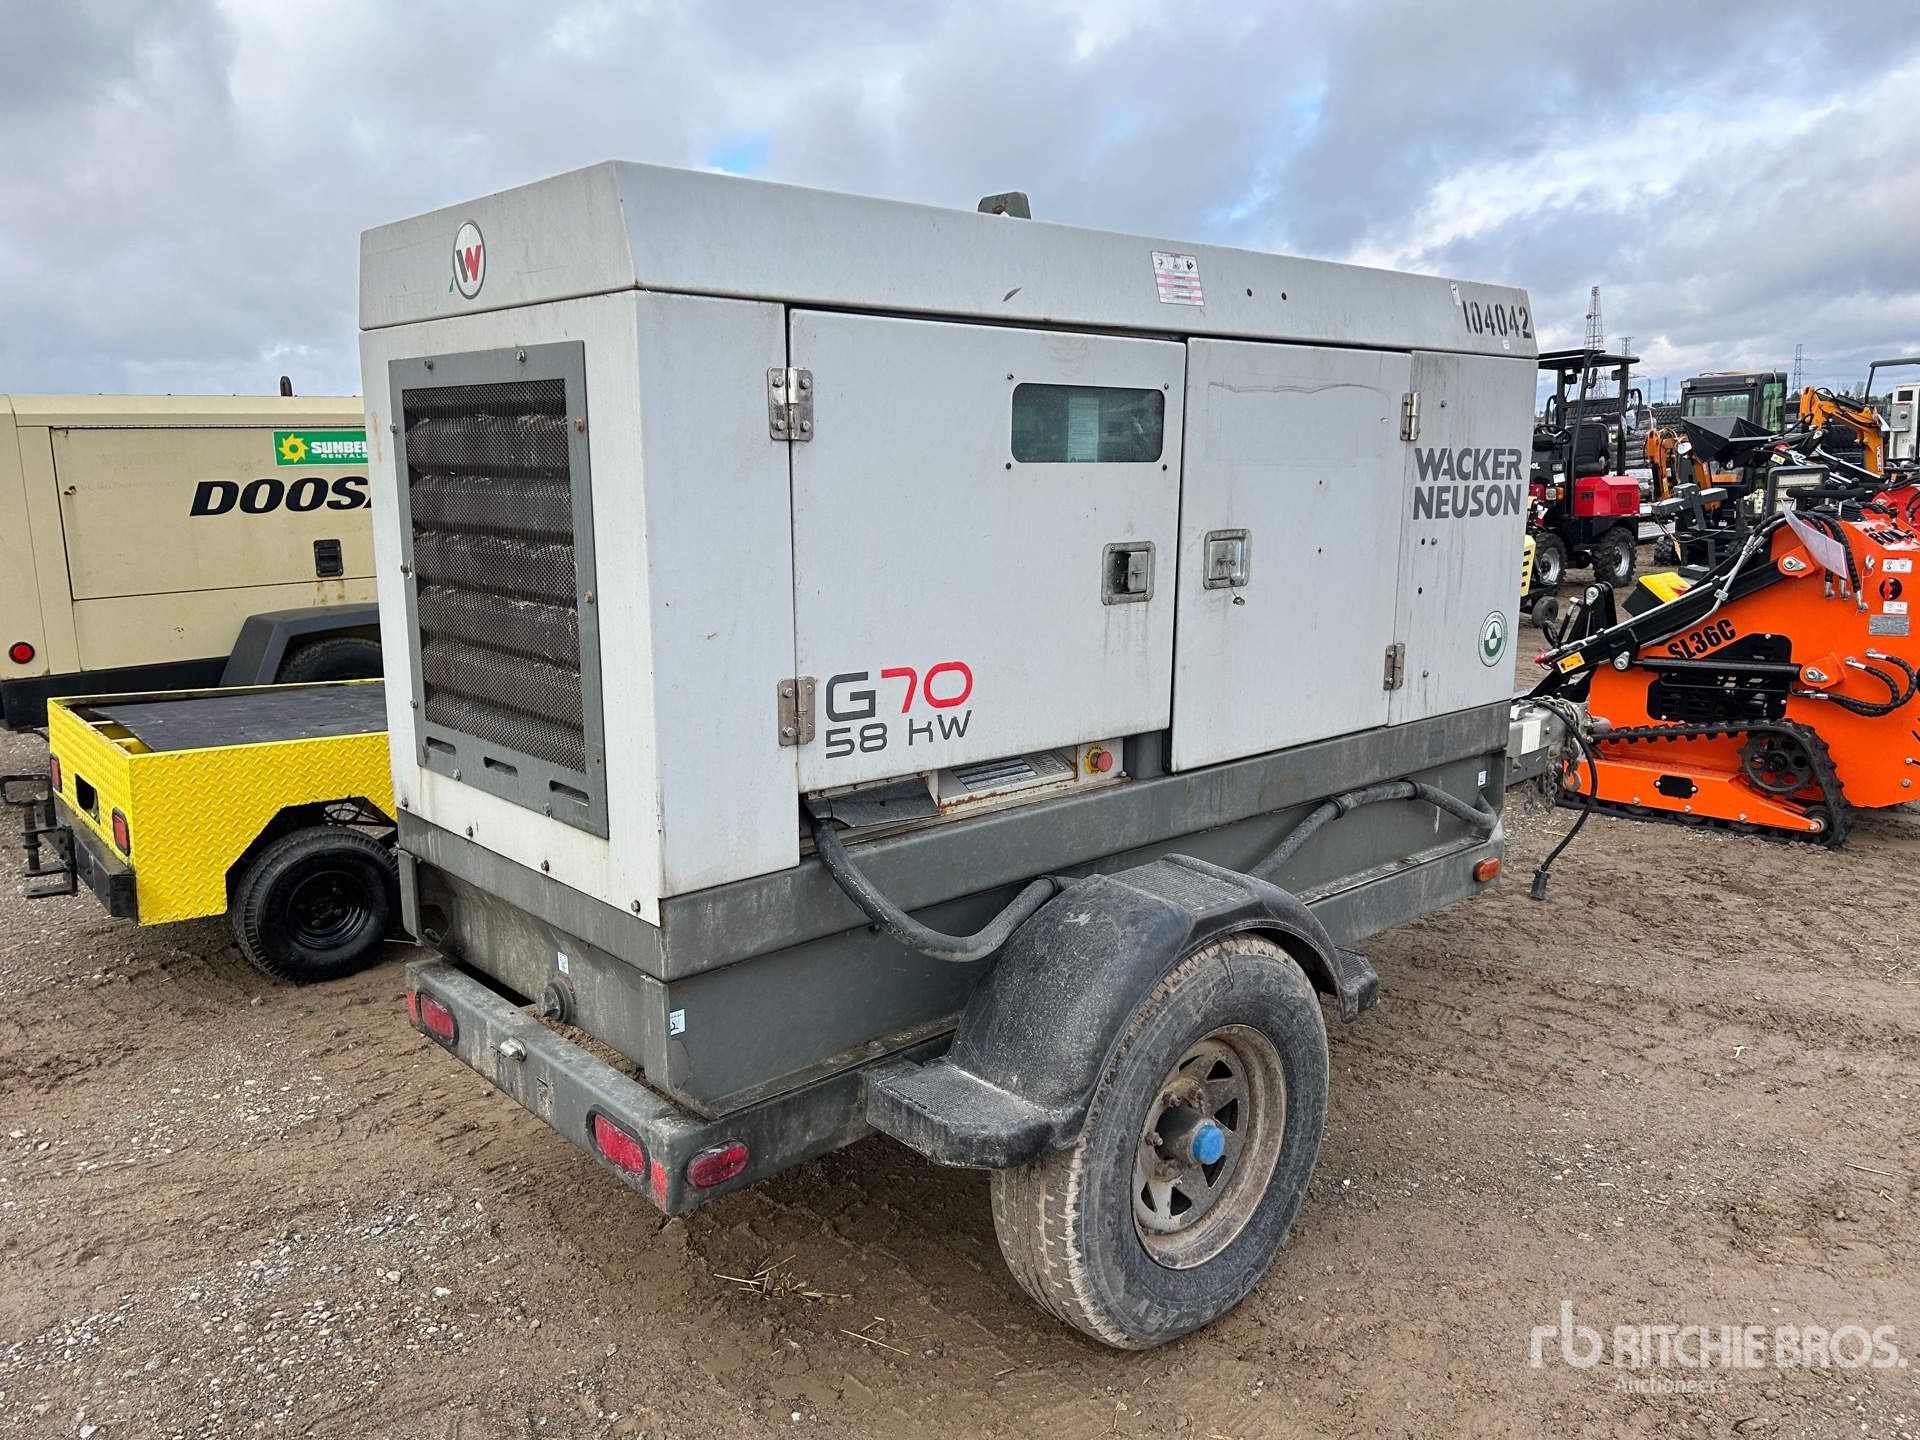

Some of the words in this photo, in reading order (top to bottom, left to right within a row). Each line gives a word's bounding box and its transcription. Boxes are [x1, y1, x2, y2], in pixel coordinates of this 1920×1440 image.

[1462, 300, 1532, 339] 104042
[1414, 447, 1522, 481] WACKER
[189, 476, 372, 516] DOOS
[1413, 484, 1522, 520] NEUSON
[1667, 618, 1736, 659] SL36C
[825, 661, 973, 723] G70
[825, 722, 888, 759] 58
